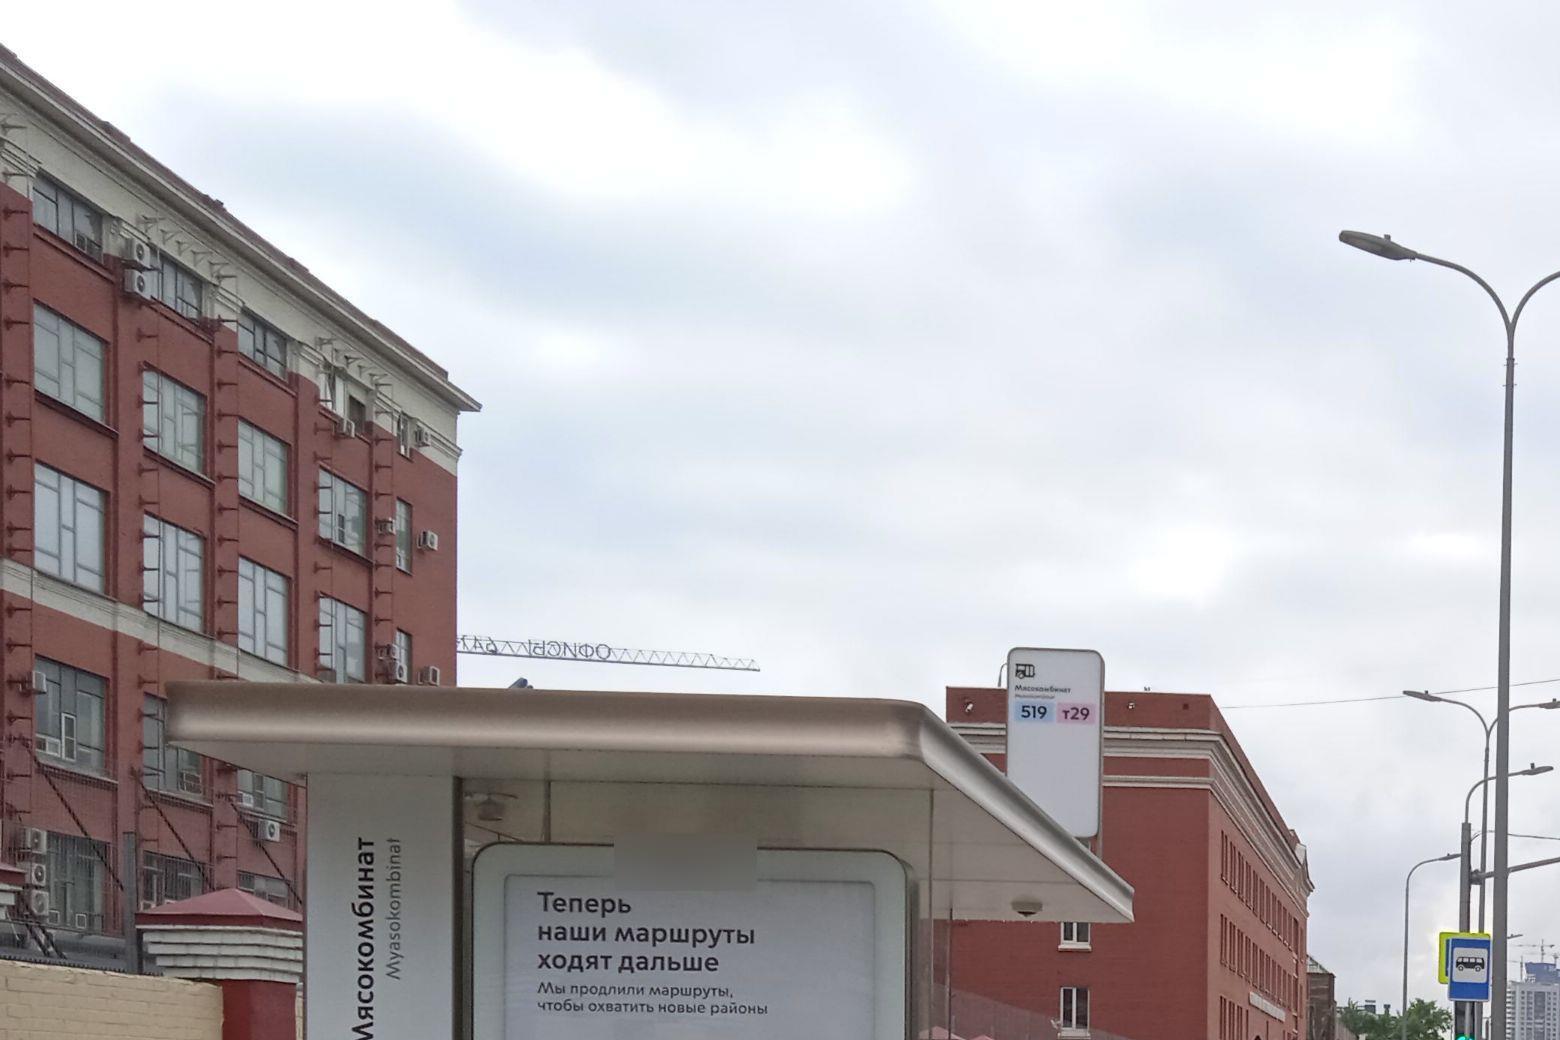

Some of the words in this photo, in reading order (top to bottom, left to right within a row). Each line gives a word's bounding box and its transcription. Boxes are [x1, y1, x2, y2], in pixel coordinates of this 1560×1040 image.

[1021, 705, 1047, 719] 519
[385, 837, 404, 981] Myasokombinat
[537, 891, 632, 918] Теперь
[538, 924, 606, 942] наши
[614, 926, 755, 948] маршруты
[537, 953, 613, 973] ходят
[617, 954, 719, 974] дальше
[537, 981, 566, 995] Мы
[570, 983, 645, 1000] продлили
[649, 985, 734, 1000] маршруты,
[537, 998, 584, 1012] чтобы
[588, 1000, 654, 1013] охватить
[658, 1002, 706, 1014] новые
[710, 1001, 769, 1016] районы
